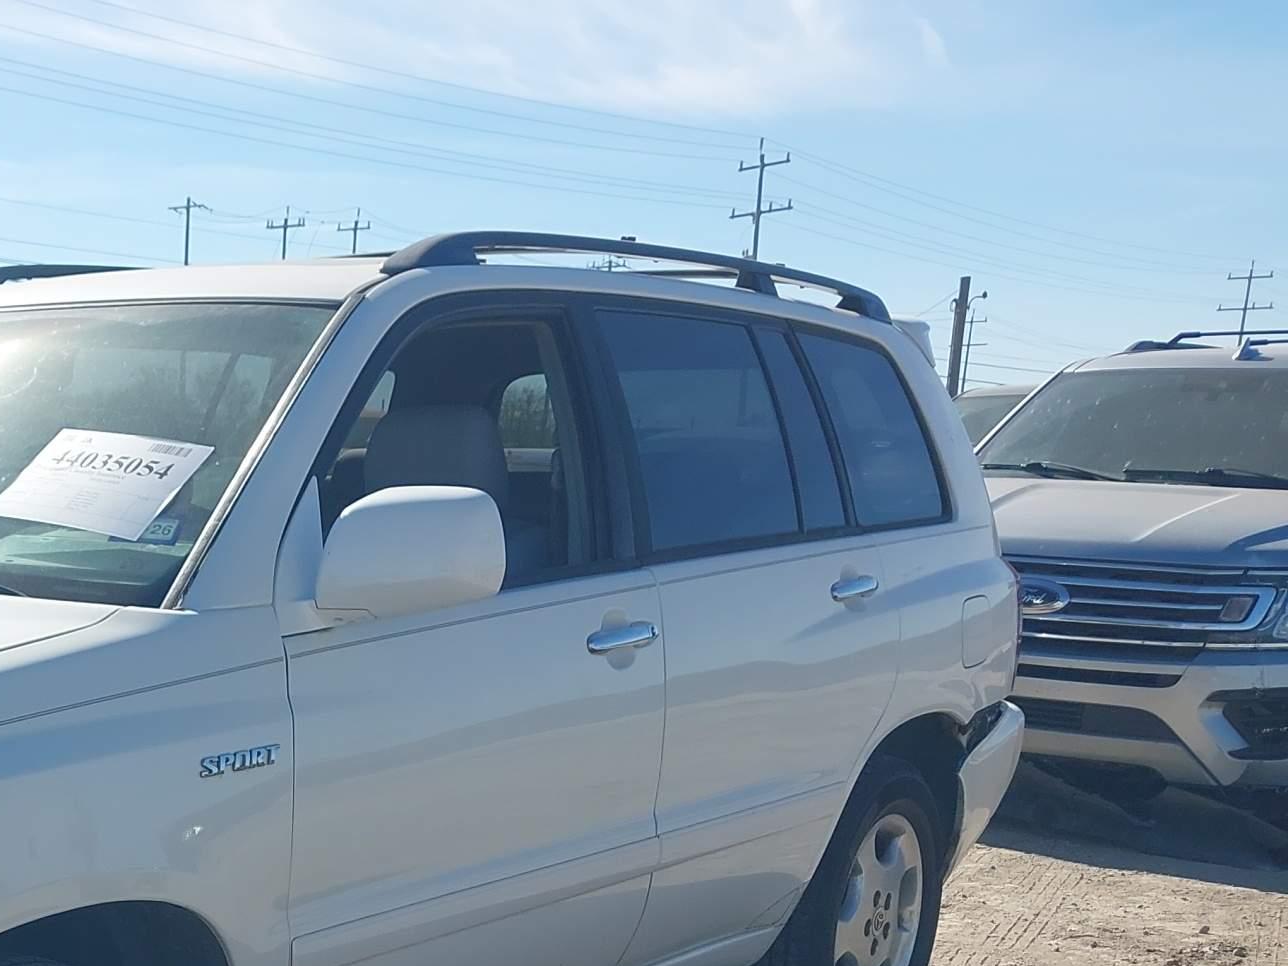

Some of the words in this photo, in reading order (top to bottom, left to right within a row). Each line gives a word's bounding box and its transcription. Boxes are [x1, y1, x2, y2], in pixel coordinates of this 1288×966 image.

[51, 449, 175, 481] 44035054
[150, 524, 173, 536] 26
[200, 743, 281, 778] SPORT
